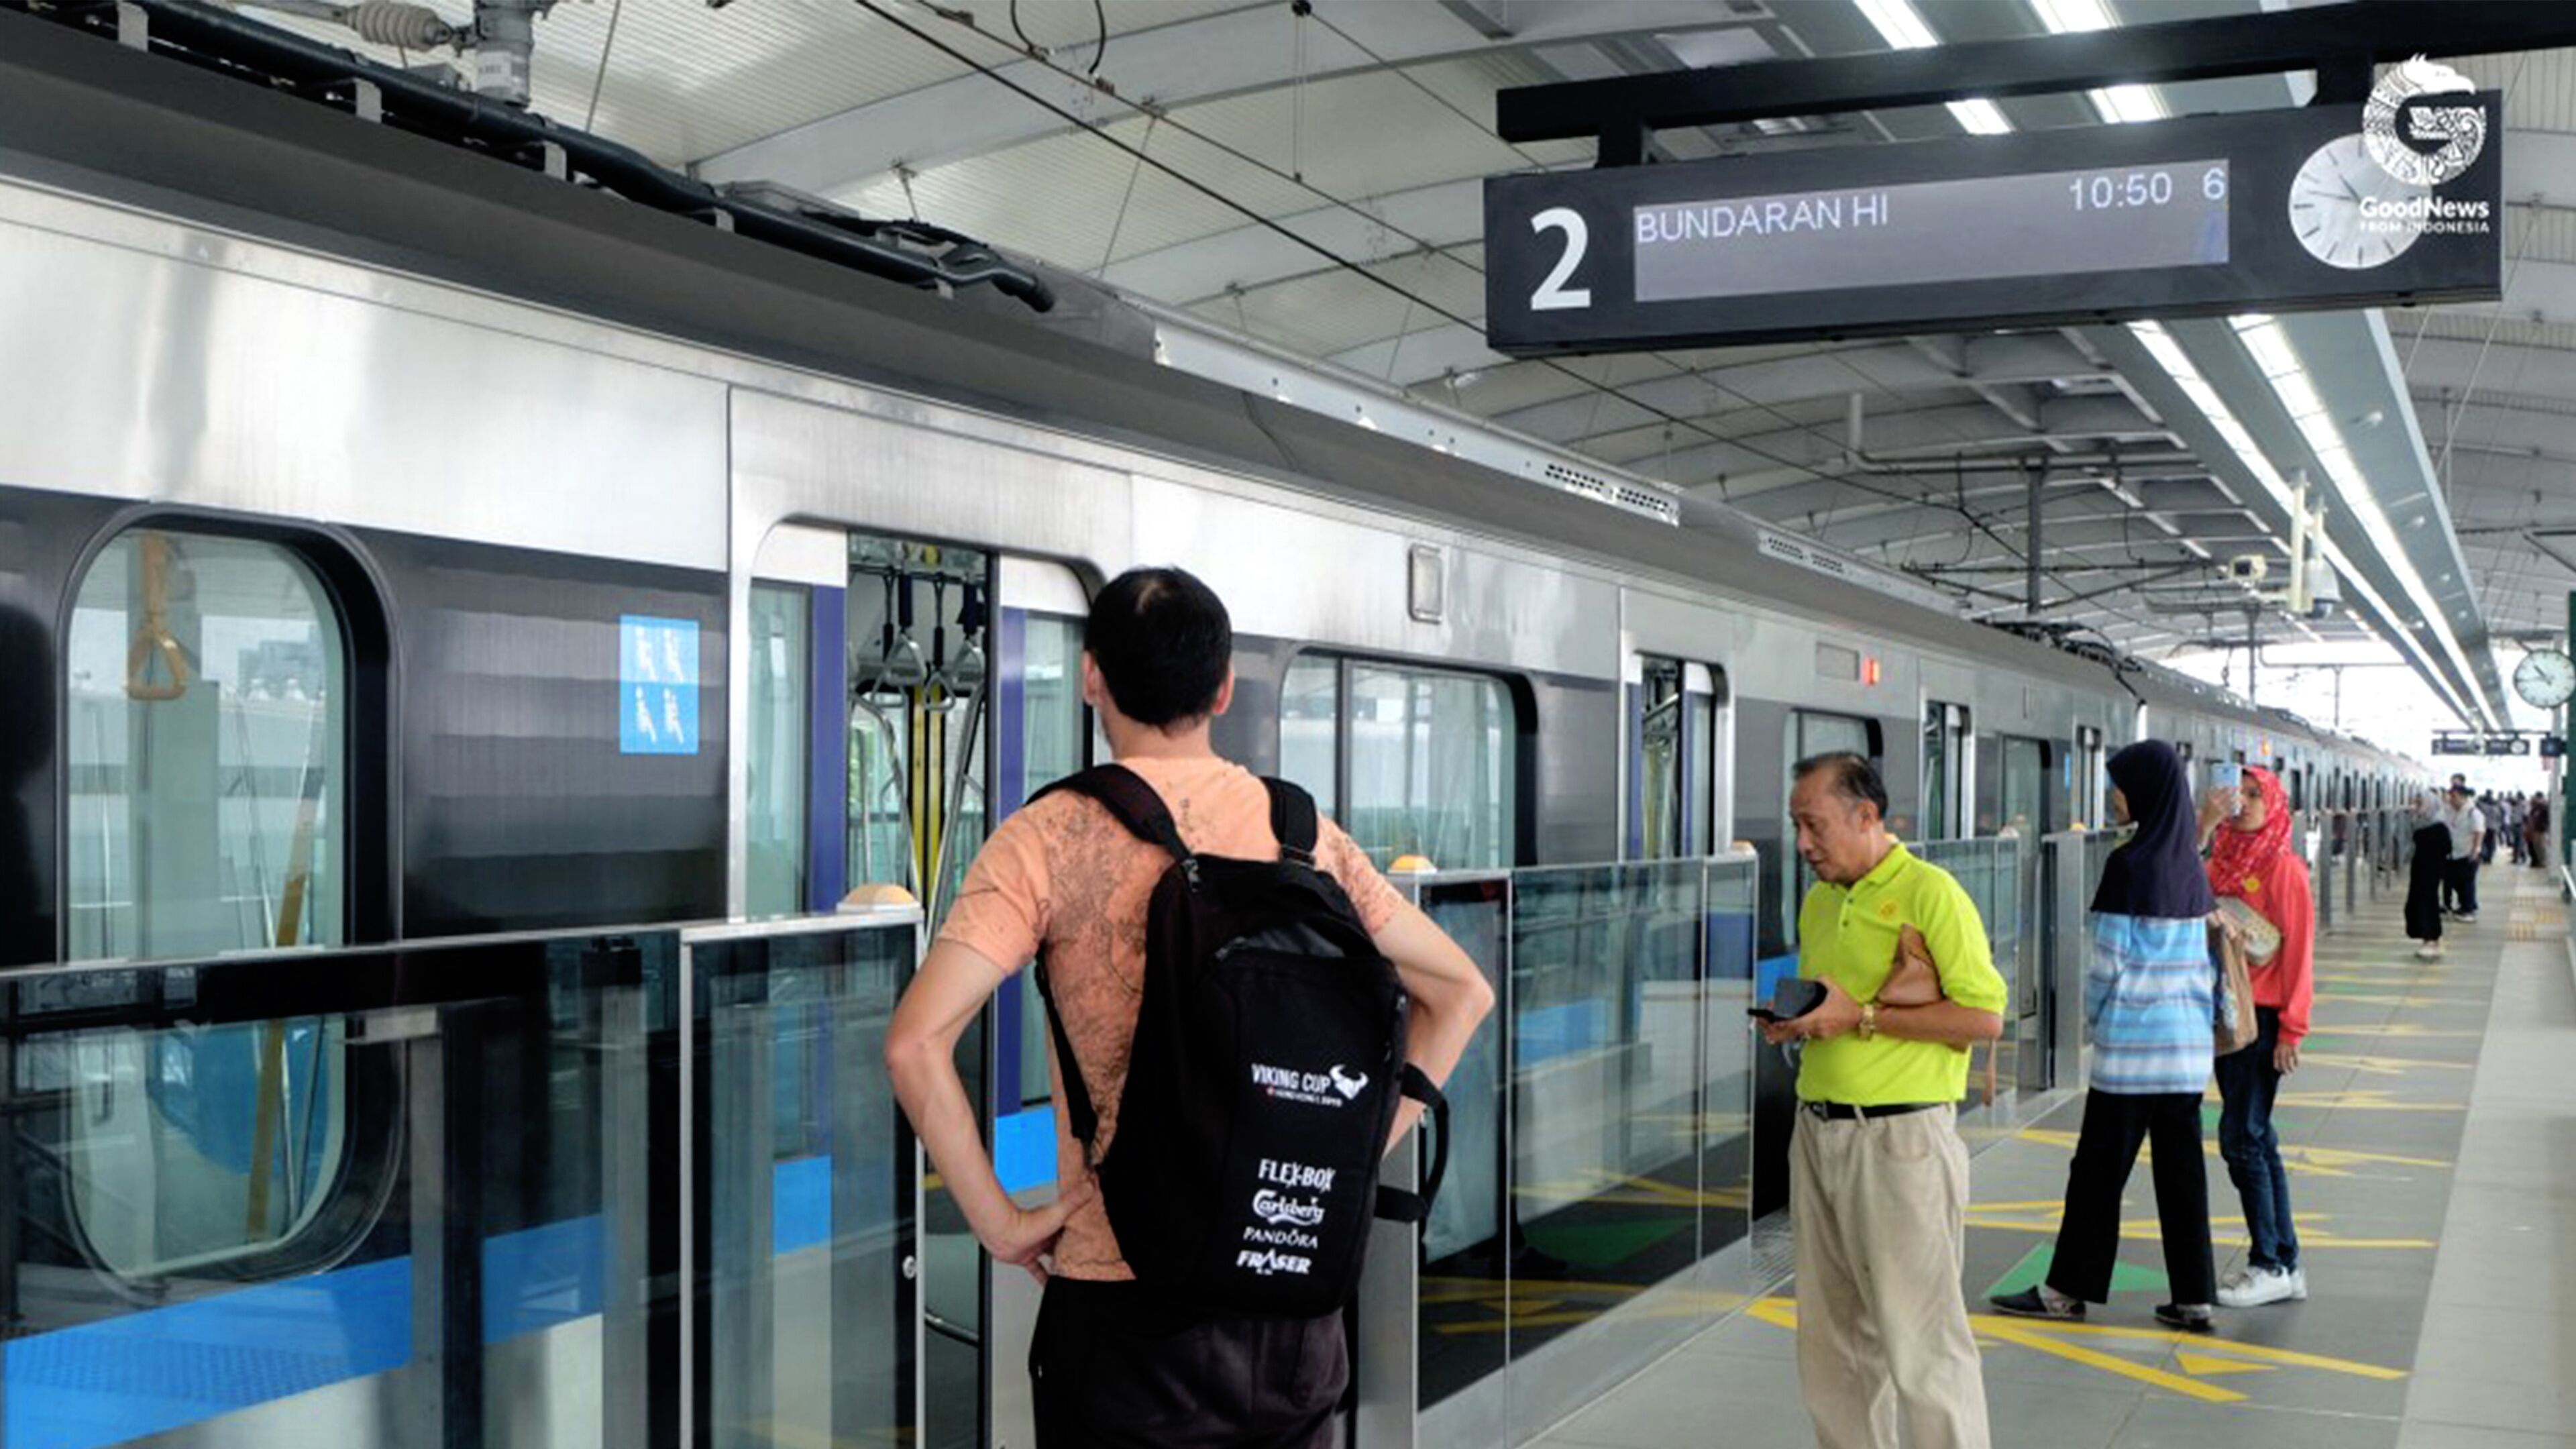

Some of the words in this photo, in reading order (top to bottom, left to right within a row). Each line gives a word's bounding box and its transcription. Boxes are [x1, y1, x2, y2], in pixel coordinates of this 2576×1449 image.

[1637, 199, 1841, 243] BUNDARAN
[1853, 193, 1888, 227] HI
[2070, 172, 2172, 211] 10:50
[2203, 167, 2225, 200] 6
[1530, 207, 1591, 311] 2
[1251, 1063, 1299, 1089] VIKING
[1301, 1072, 1332, 1094] CUP
[1258, 1158, 1336, 1194] FLEX-BOX
[1252, 1188, 1326, 1226] Carlsberg
[1242, 1226, 1318, 1250] PANDORA
[1236, 1248, 1312, 1275] FRASER
